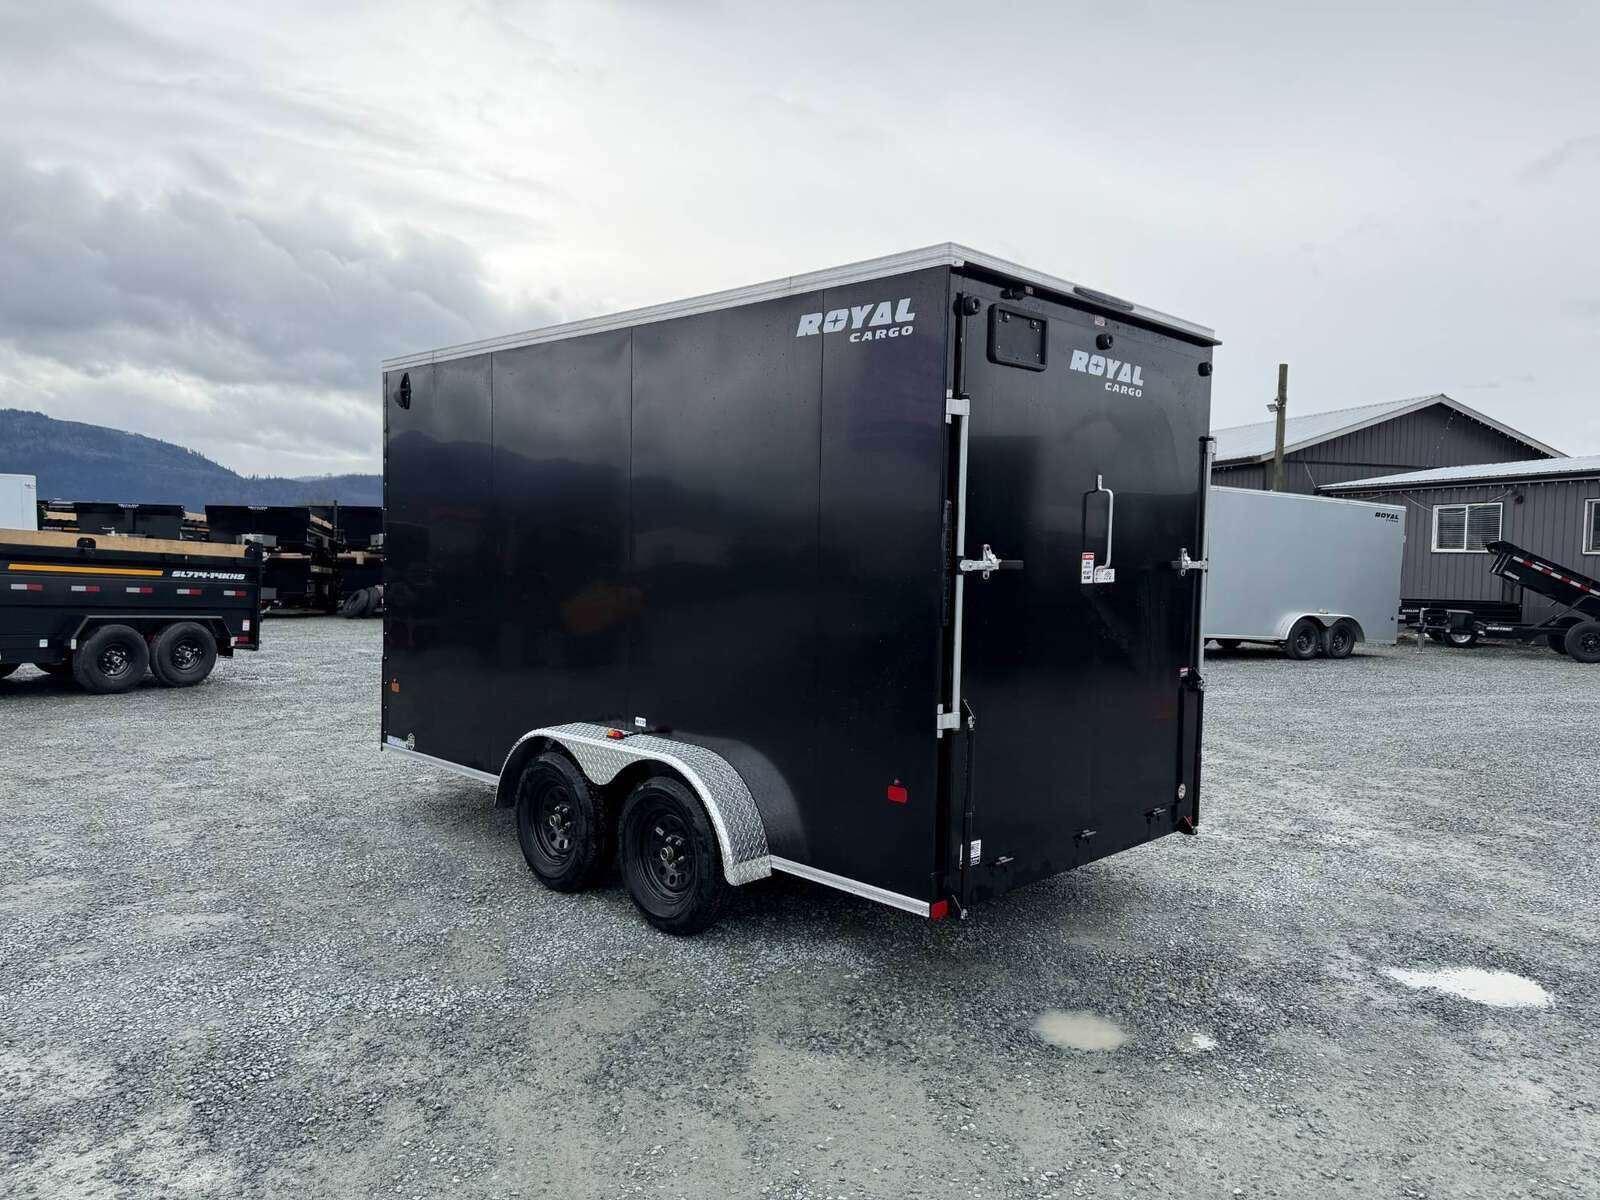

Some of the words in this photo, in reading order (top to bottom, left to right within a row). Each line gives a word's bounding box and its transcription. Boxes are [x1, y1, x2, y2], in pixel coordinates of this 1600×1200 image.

[795, 297, 916, 338] ROYAL
[849, 325, 914, 343] CARGO
[1069, 349, 1144, 386] ROYAL
[1105, 382, 1143, 398] CARGO
